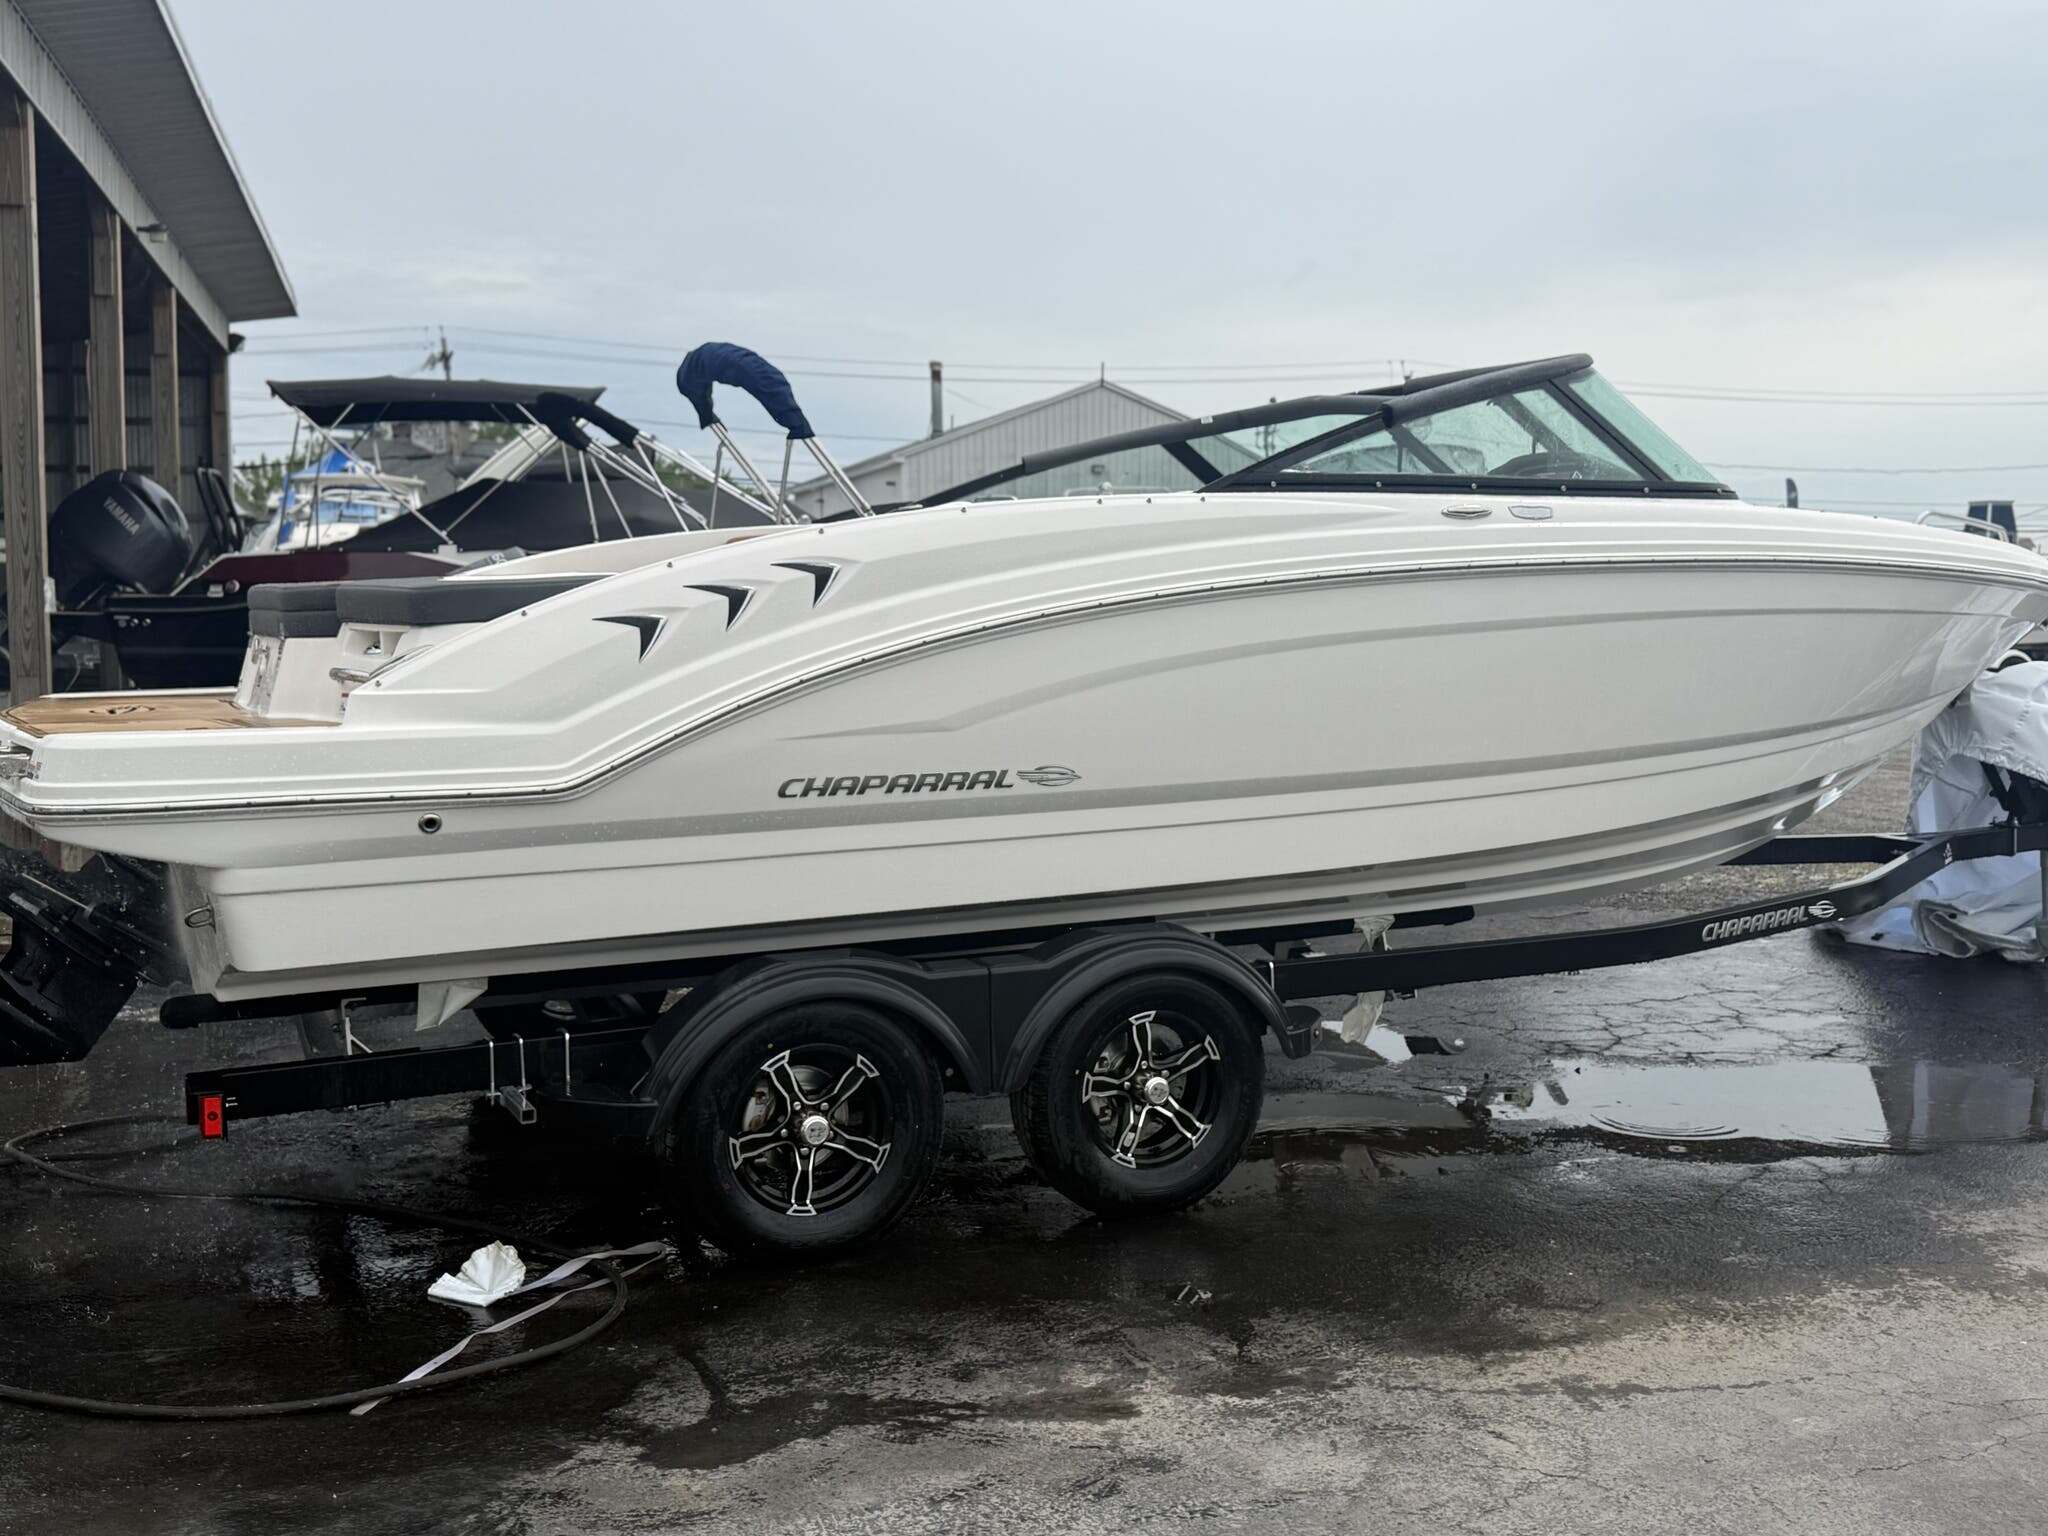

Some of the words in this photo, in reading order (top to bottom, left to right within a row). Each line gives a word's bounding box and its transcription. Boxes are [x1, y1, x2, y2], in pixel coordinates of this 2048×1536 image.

[103, 496, 140, 535] YAMAHA
[778, 770, 1014, 798] CHAPARRAL
[1702, 905, 1808, 942] CHAPARRAL
